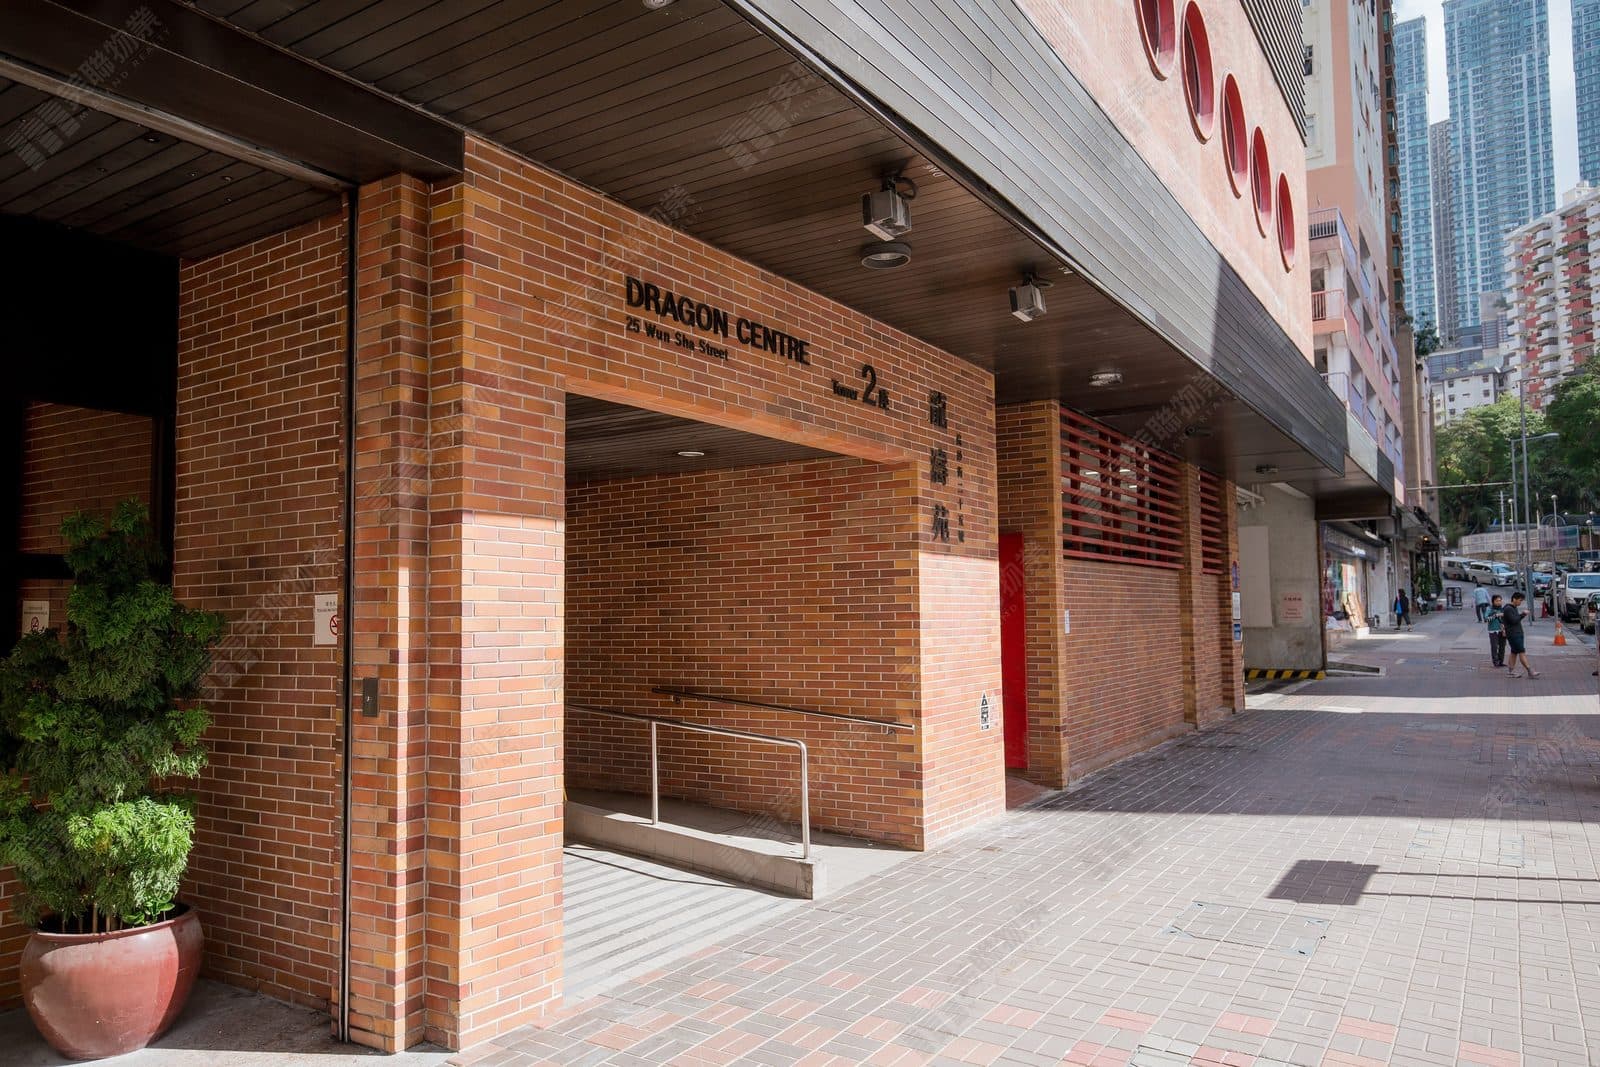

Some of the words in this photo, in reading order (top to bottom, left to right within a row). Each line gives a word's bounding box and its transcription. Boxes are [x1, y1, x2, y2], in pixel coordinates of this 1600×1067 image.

[625, 276, 729, 339] DRAGON
[736, 317, 811, 366] CENTRE
[625, 315, 641, 334] 25
[645, 321, 671, 344] Wun
[675, 330, 695, 352] Sha
[699, 342, 729, 362] Street
[831, 378, 859, 401] Tower
[862, 364, 877, 407] 2
